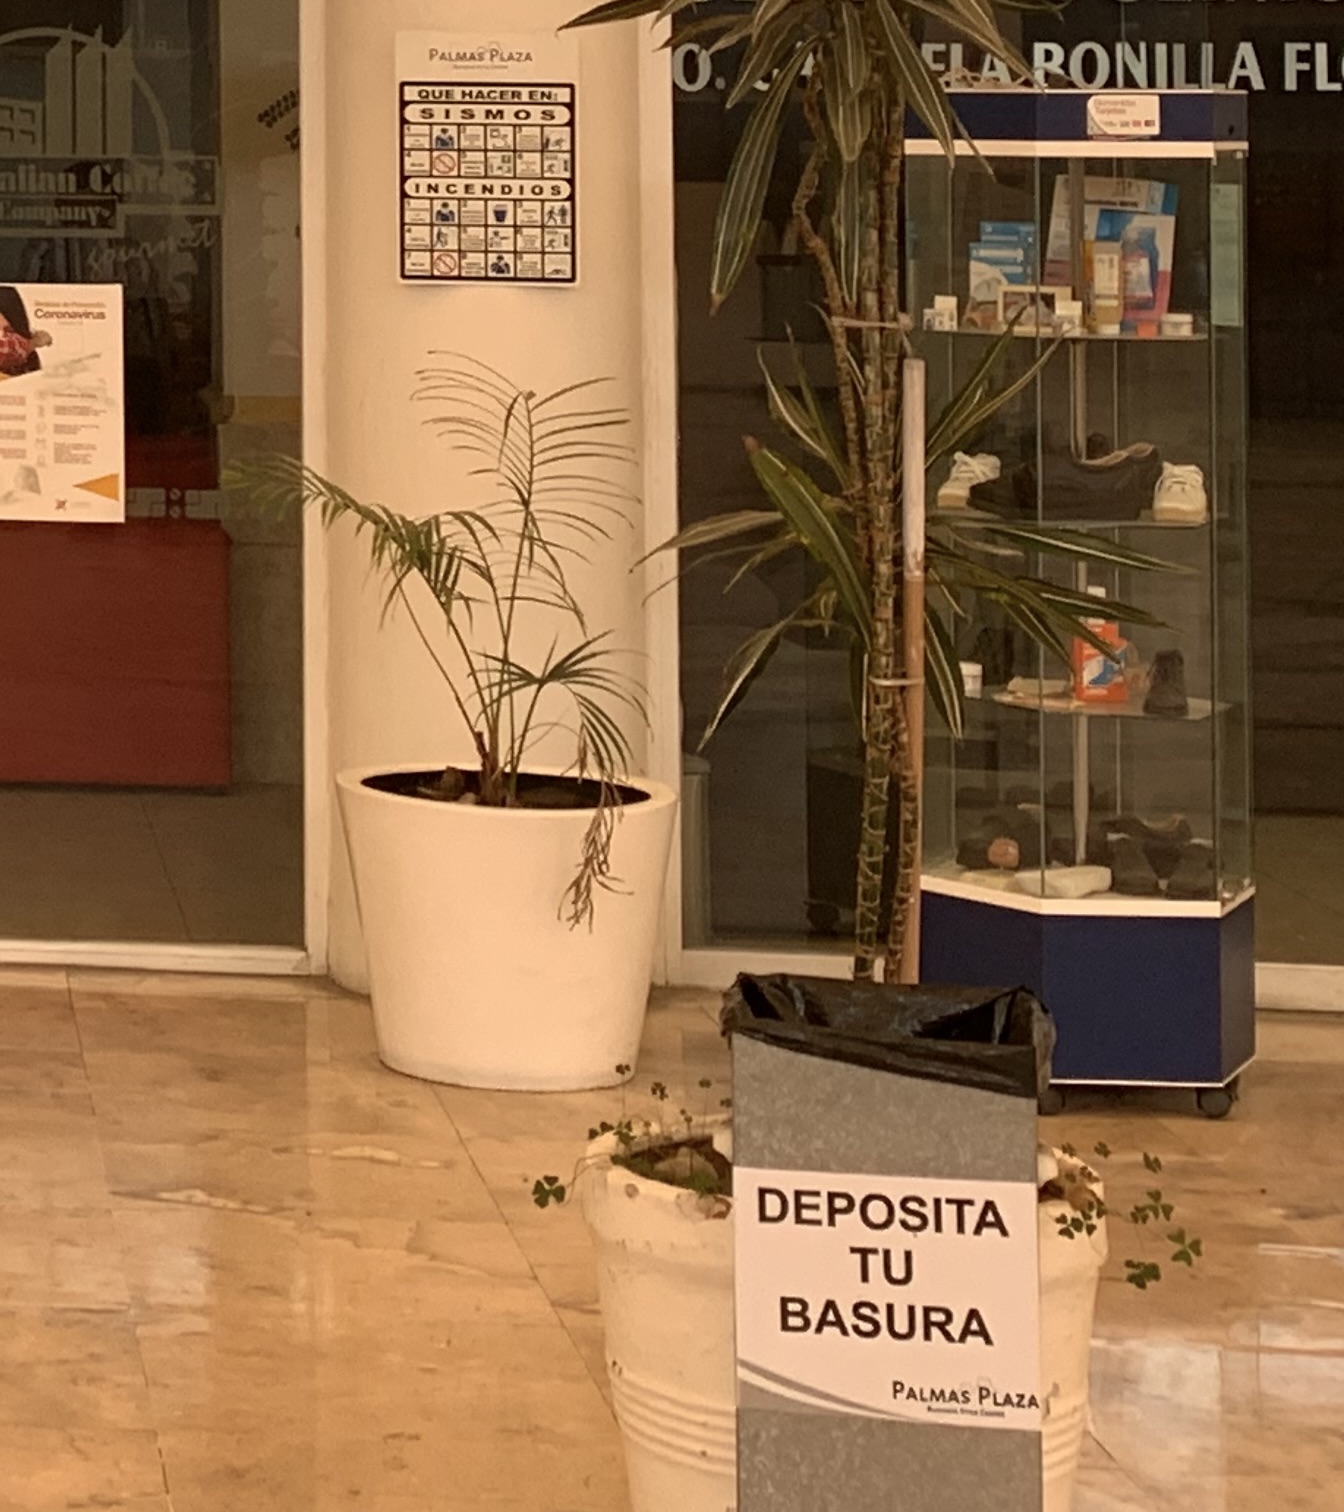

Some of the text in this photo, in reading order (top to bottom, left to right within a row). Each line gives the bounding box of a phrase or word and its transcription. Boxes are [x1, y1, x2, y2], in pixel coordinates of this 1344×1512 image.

[429, 47, 533, 62] PALMAS PLAZA
[1033, 41, 1266, 91] BONILLA
[1283, 42, 1344, 91] FL
[417, 89, 455, 101] QUE
[462, 89, 522, 101] HACER
[419, 108, 556, 121] SISMOS
[414, 183, 562, 196] INCENDIOS
[34, 308, 106, 320] Coronavirus
[757, 1186, 1010, 1238] DEPOSITA
[849, 1246, 913, 1286] TU
[779, 1295, 994, 1347] BASURA
[892, 1380, 1040, 1410] PALMAS PLAZA
